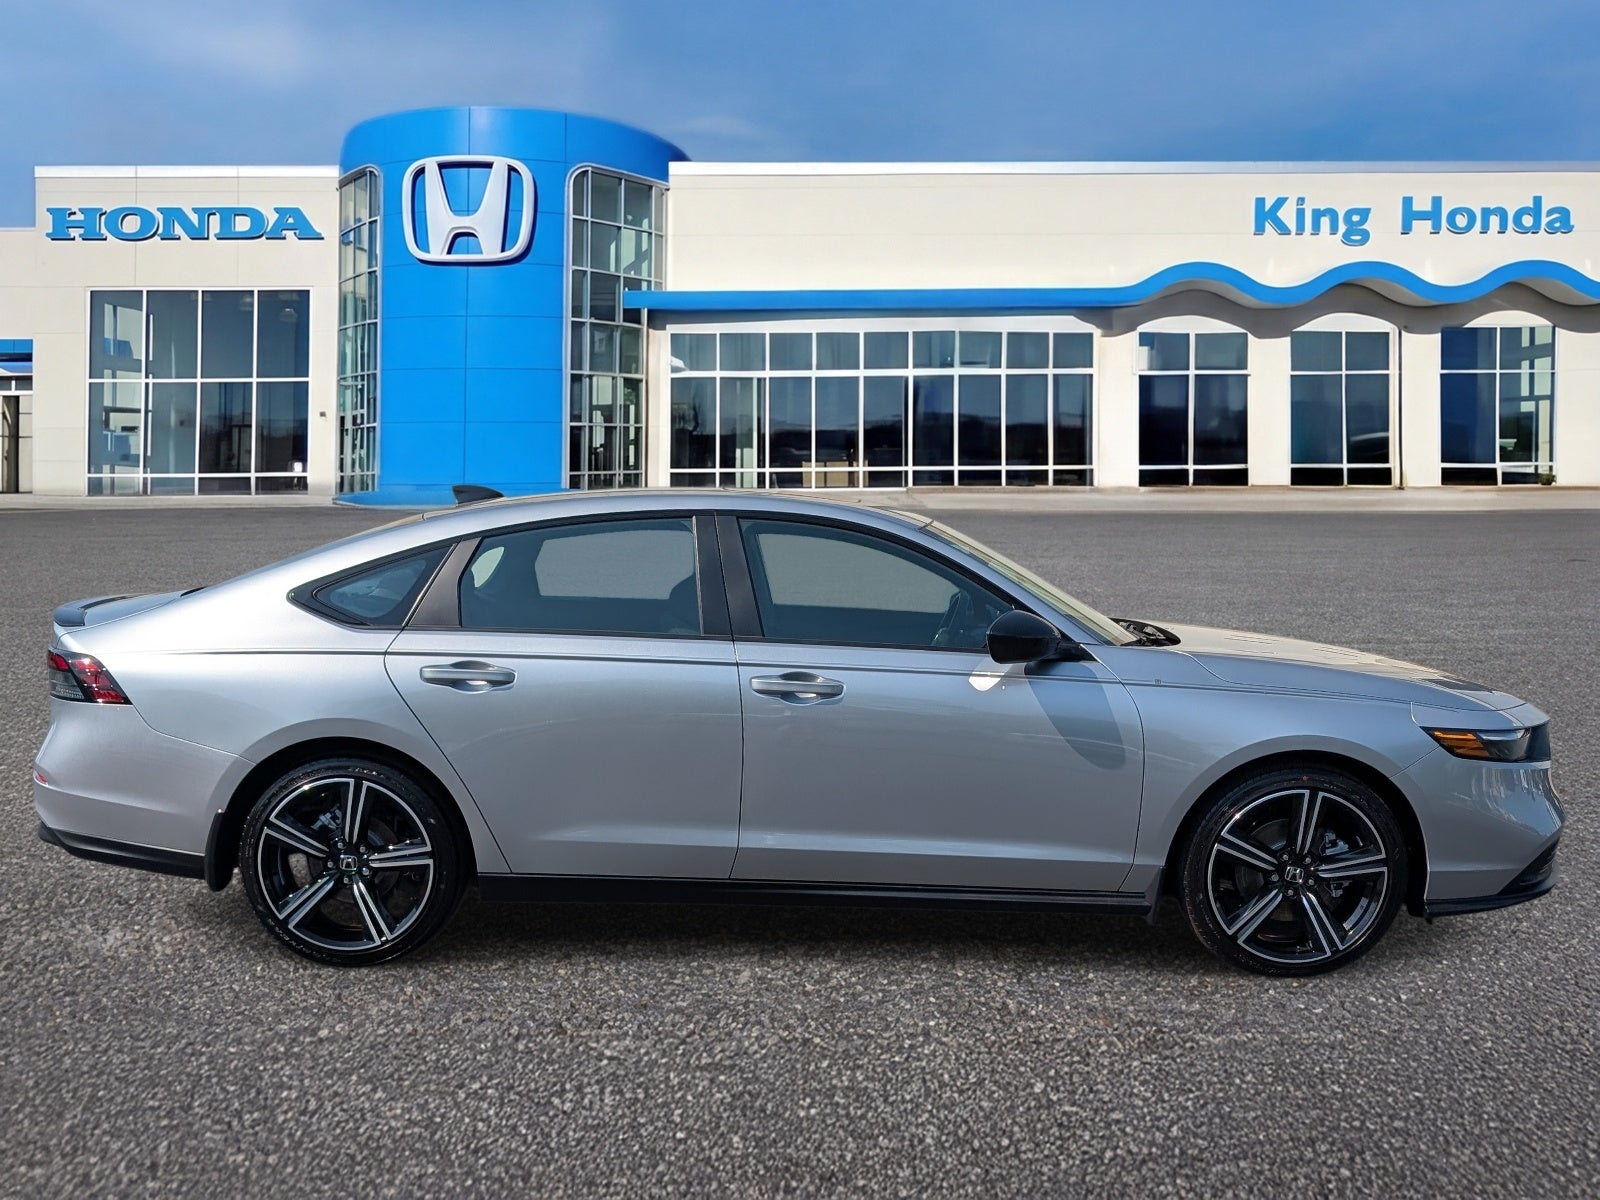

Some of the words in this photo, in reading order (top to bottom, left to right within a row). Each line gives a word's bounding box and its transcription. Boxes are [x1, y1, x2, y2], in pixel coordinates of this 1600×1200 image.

[45, 206, 324, 241] HONDA
[1253, 196, 1372, 246] King
[1400, 195, 1575, 235] Honda
